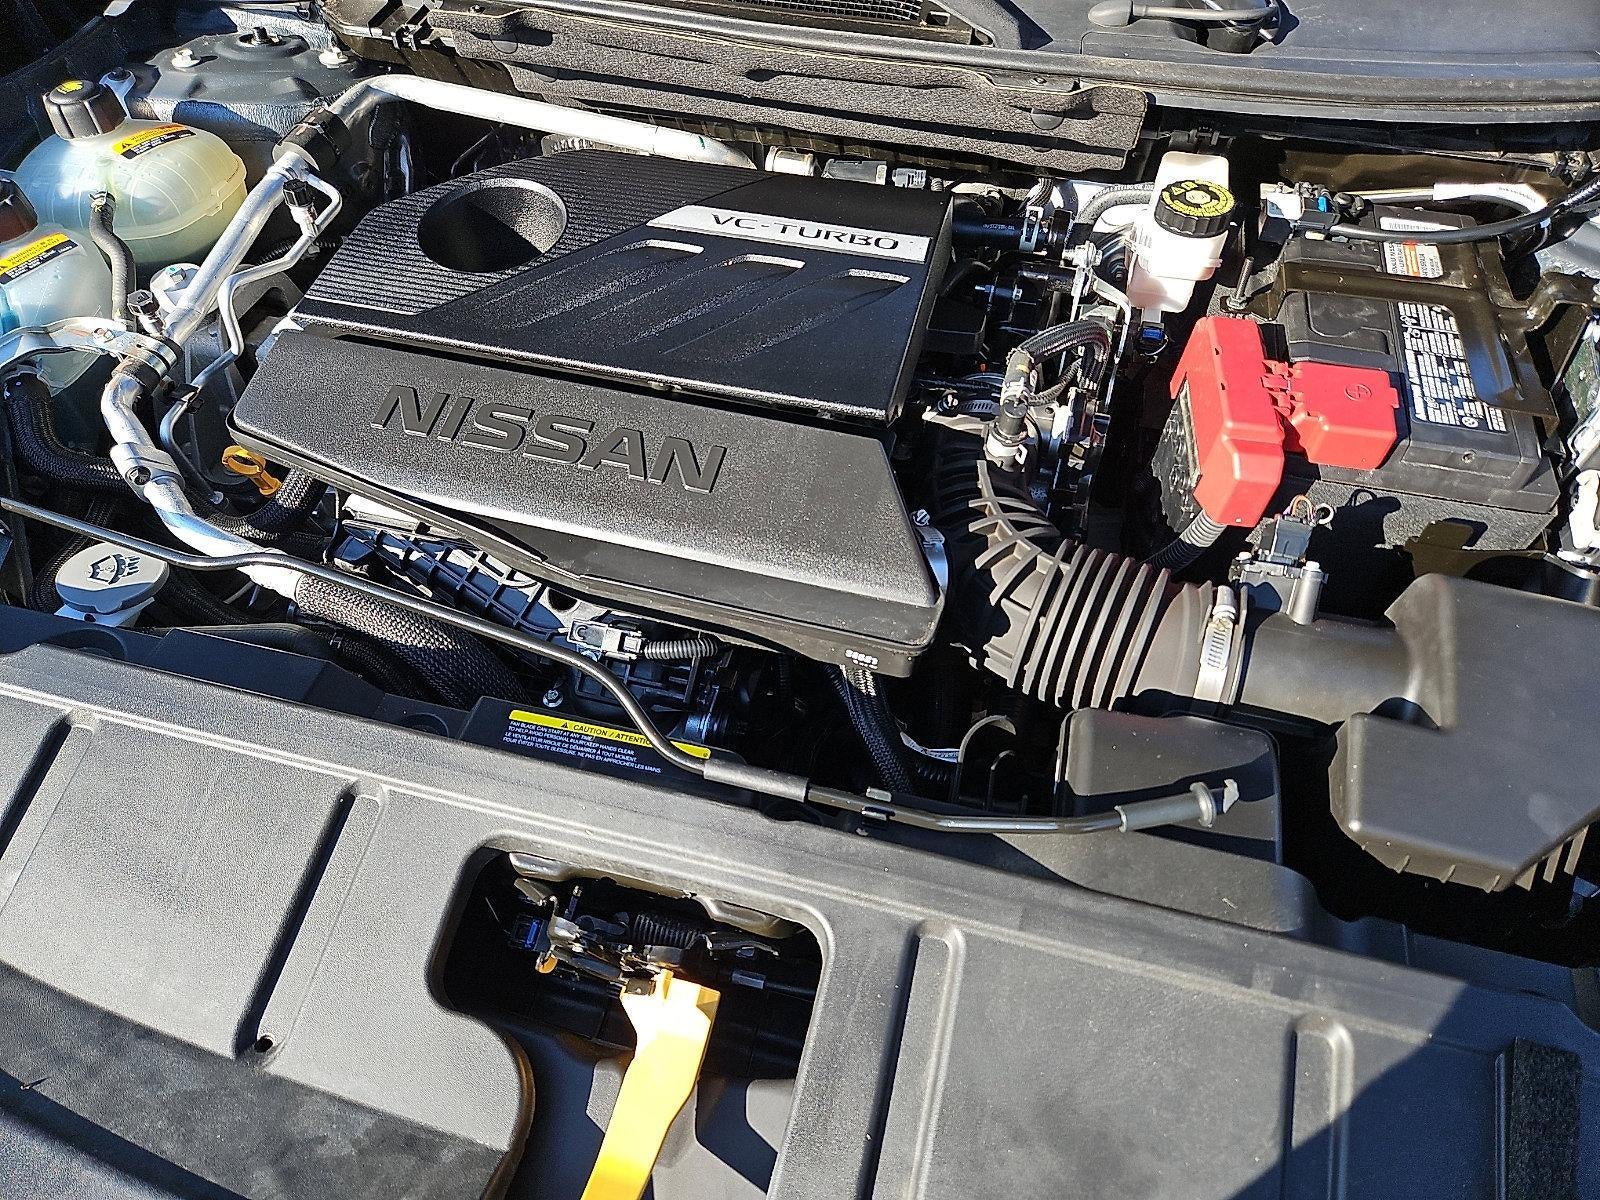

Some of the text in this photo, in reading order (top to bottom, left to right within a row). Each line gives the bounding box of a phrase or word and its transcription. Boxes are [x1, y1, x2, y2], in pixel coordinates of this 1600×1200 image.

[711, 213, 899, 250] VC-TURBO
[370, 384, 728, 494] NISSAN
[573, 724, 608, 737] CAUTION
[614, 733, 651, 745] ATTENTIO
